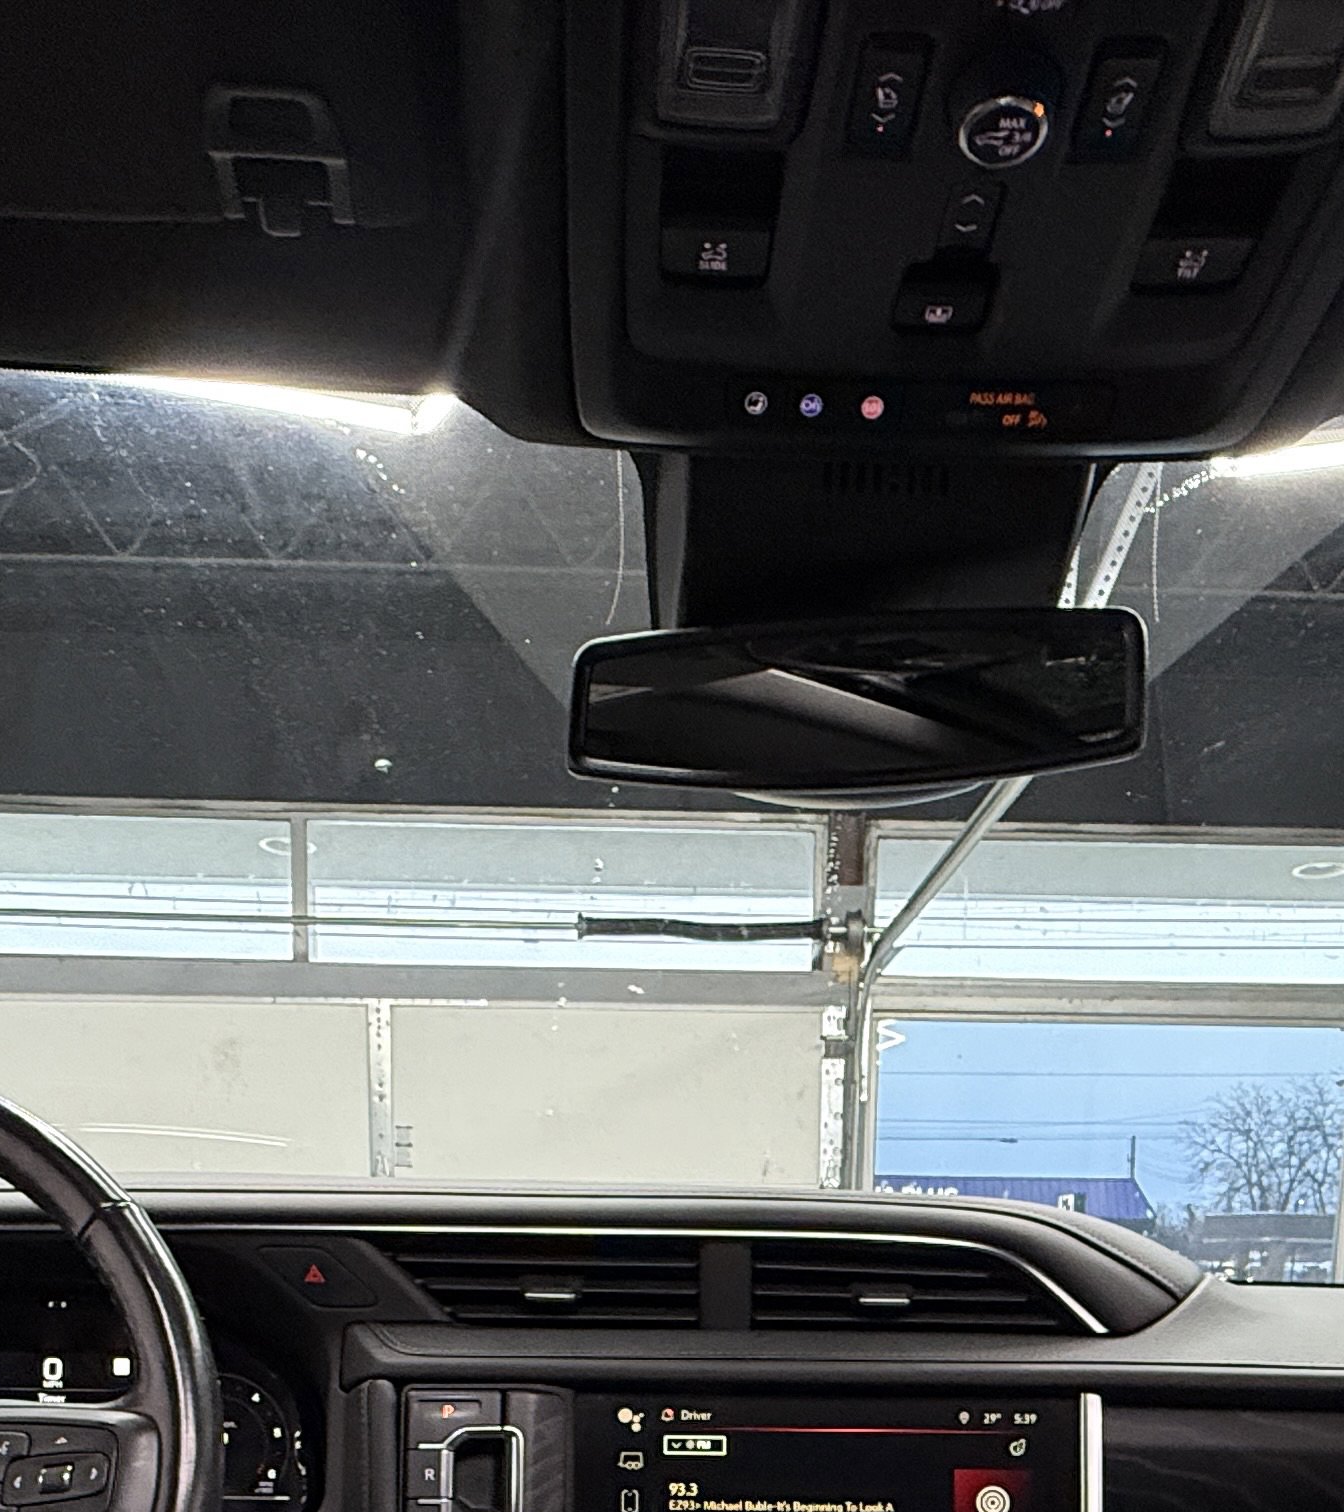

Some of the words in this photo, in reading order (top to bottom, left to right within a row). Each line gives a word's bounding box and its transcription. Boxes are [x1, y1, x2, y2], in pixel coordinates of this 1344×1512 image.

[43, 1357, 63, 1381] 0
[441, 1404, 456, 1419] P
[681, 1409, 712, 1421] Driver
[424, 1468, 436, 1481] R
[668, 1482, 699, 1497] 93.3
[703, 1500, 743, 1512] Michael
[846, 1501, 858, 1512] To
[859, 1502, 885, 1512] Look
[885, 1502, 895, 1512] A
